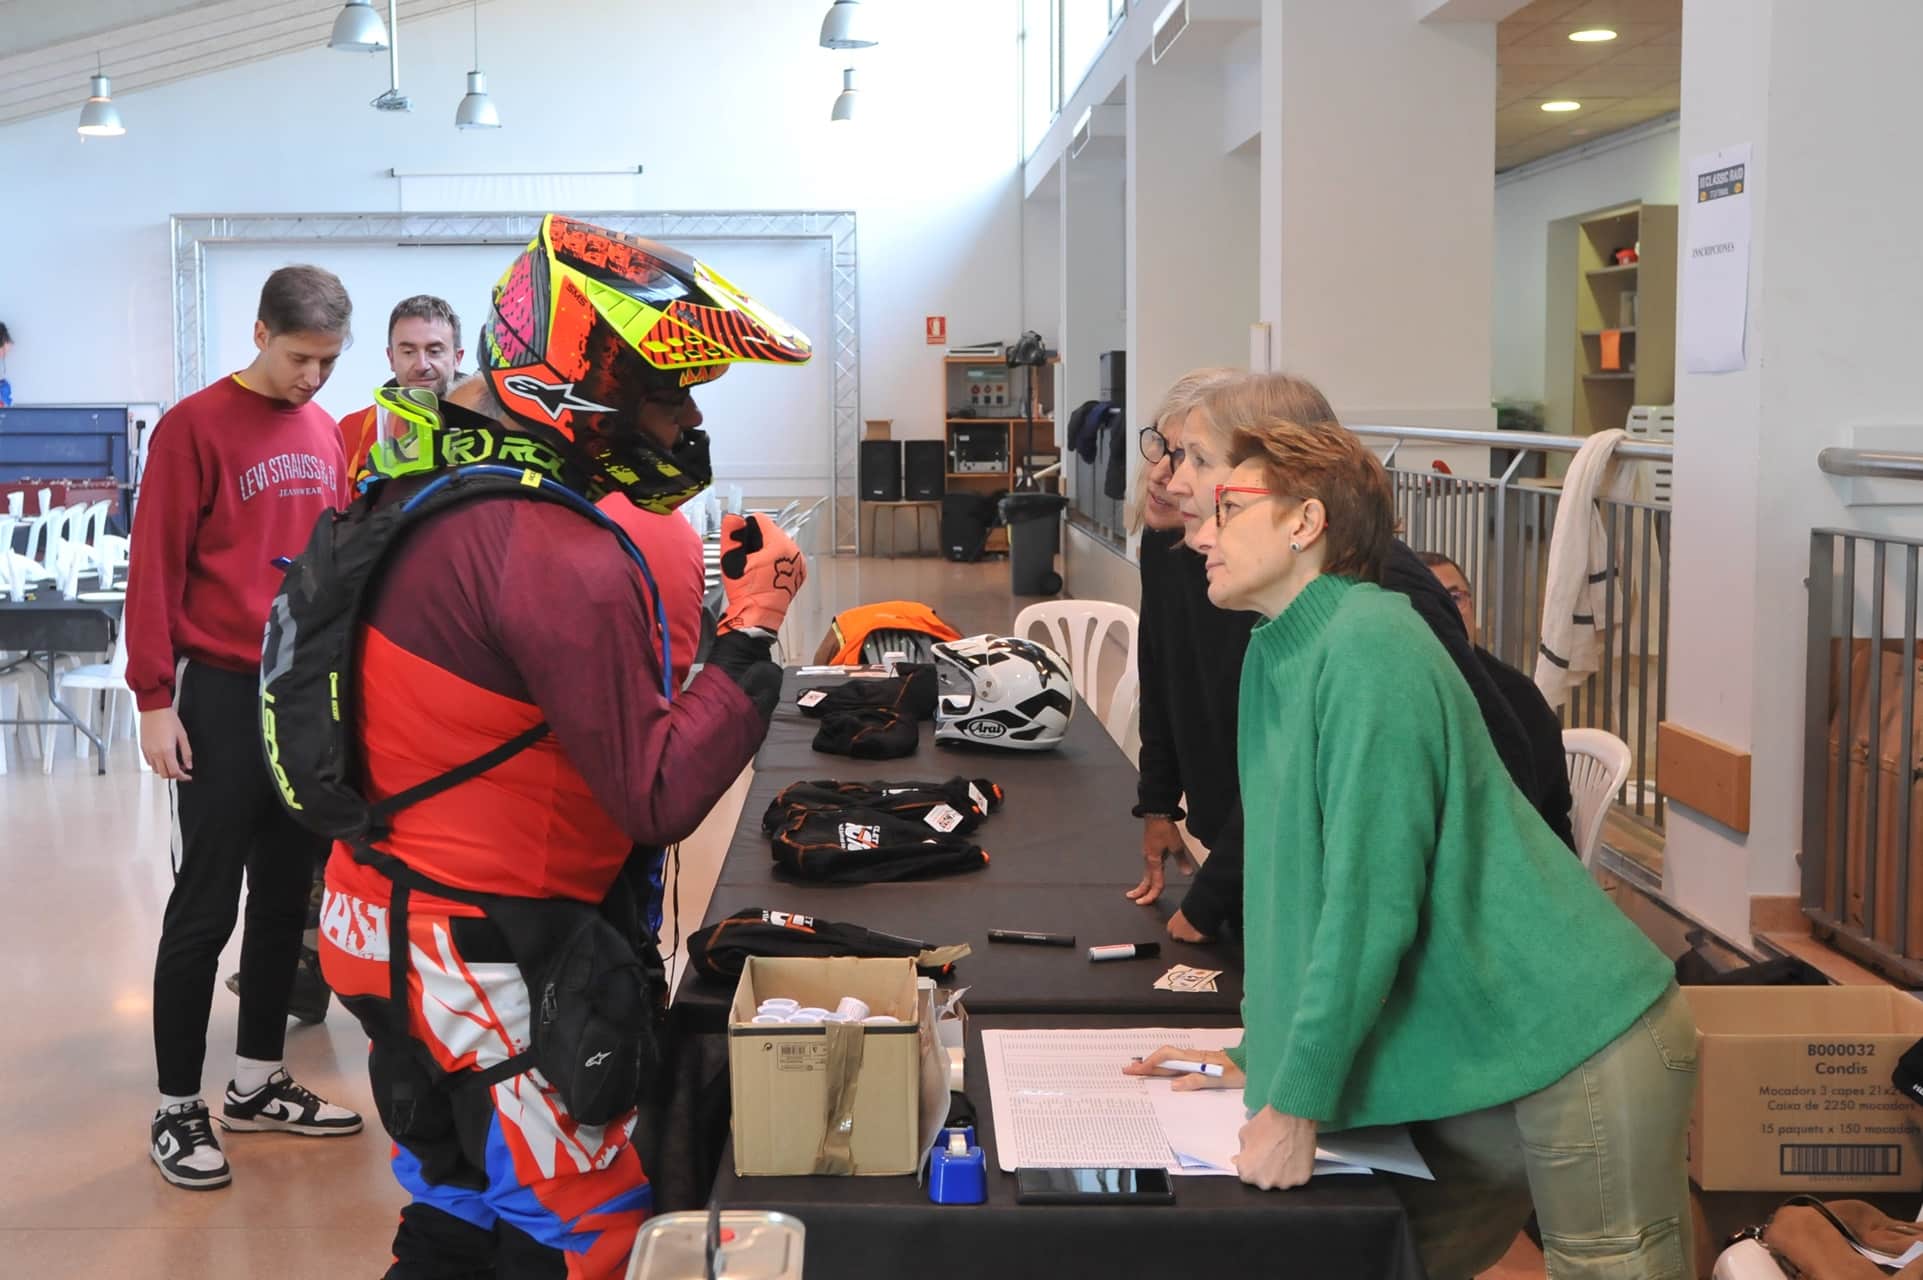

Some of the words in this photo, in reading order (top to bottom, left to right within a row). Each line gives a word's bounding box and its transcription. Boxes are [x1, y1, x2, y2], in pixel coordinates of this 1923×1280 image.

[240, 462, 270, 501] LEVI
[268, 453, 321, 483] STRAUSS
[975, 720, 1001, 733] Arai
[1807, 1044, 1876, 1057] B000032
[1815, 1062, 1868, 1075] Condis
[1759, 1085, 1817, 1096] Mocadors
[1820, 1085, 1827, 1096] 3
[1831, 1086, 1865, 1099] capes
[1869, 1085, 1897, 1096] 21x2
[1767, 1100, 1801, 1111] Caixa
[1804, 1100, 1819, 1111] de
[1823, 1100, 1856, 1111] 2250
[1761, 1123, 1774, 1134] 15
[1777, 1123, 1824, 1136] paquets
[1827, 1126, 1834, 1134] x
[1839, 1123, 1861, 1134] 150
